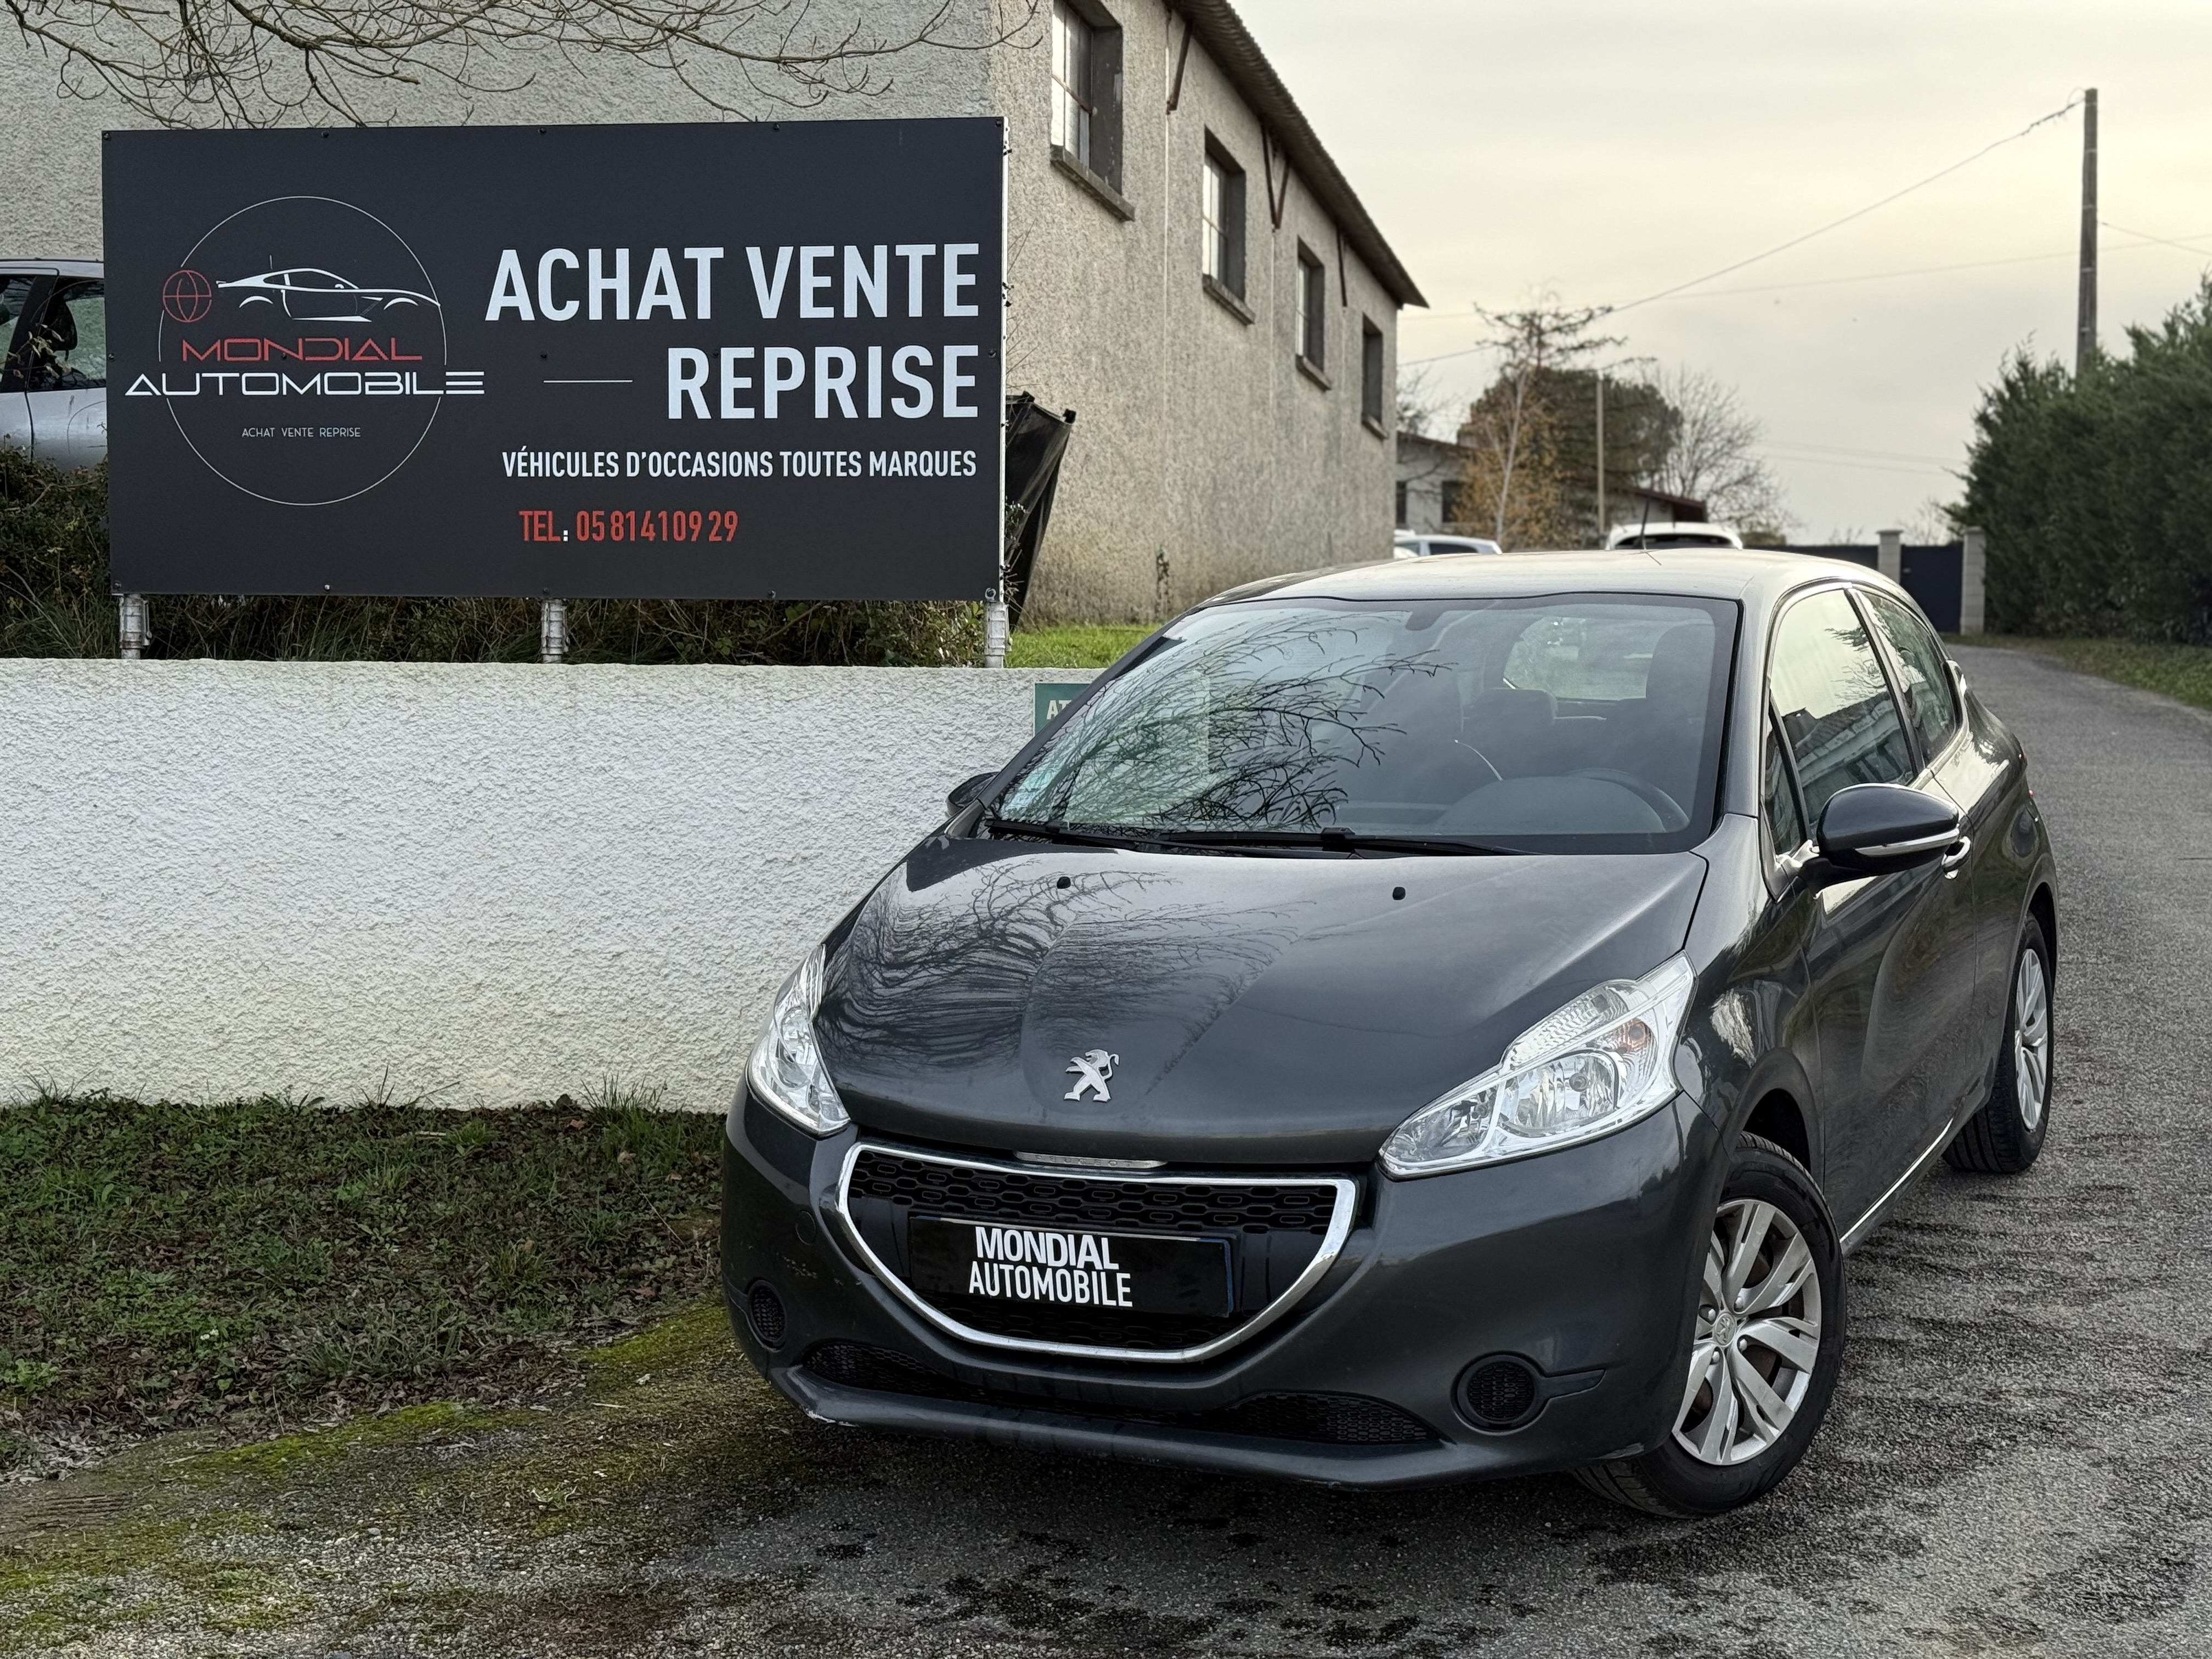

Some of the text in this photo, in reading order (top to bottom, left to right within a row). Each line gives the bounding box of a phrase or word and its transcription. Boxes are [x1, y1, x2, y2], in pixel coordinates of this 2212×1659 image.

[485, 243, 979, 321] ACHAT VENTE
[183, 338, 422, 361] MONDIAL
[125, 371, 485, 396] AUTOMOBILE
[668, 345, 979, 420] REPRISE
[241, 427, 361, 438] ACHAT VENTE REPRISE
[502, 445, 619, 477] VÉHICULES
[779, 450, 862, 477] TOUTES
[870, 450, 977, 477] MARQUES
[975, 1226, 1120, 1271] MONDIAL
[969, 1260, 1133, 1308] AUTOMOBILE
